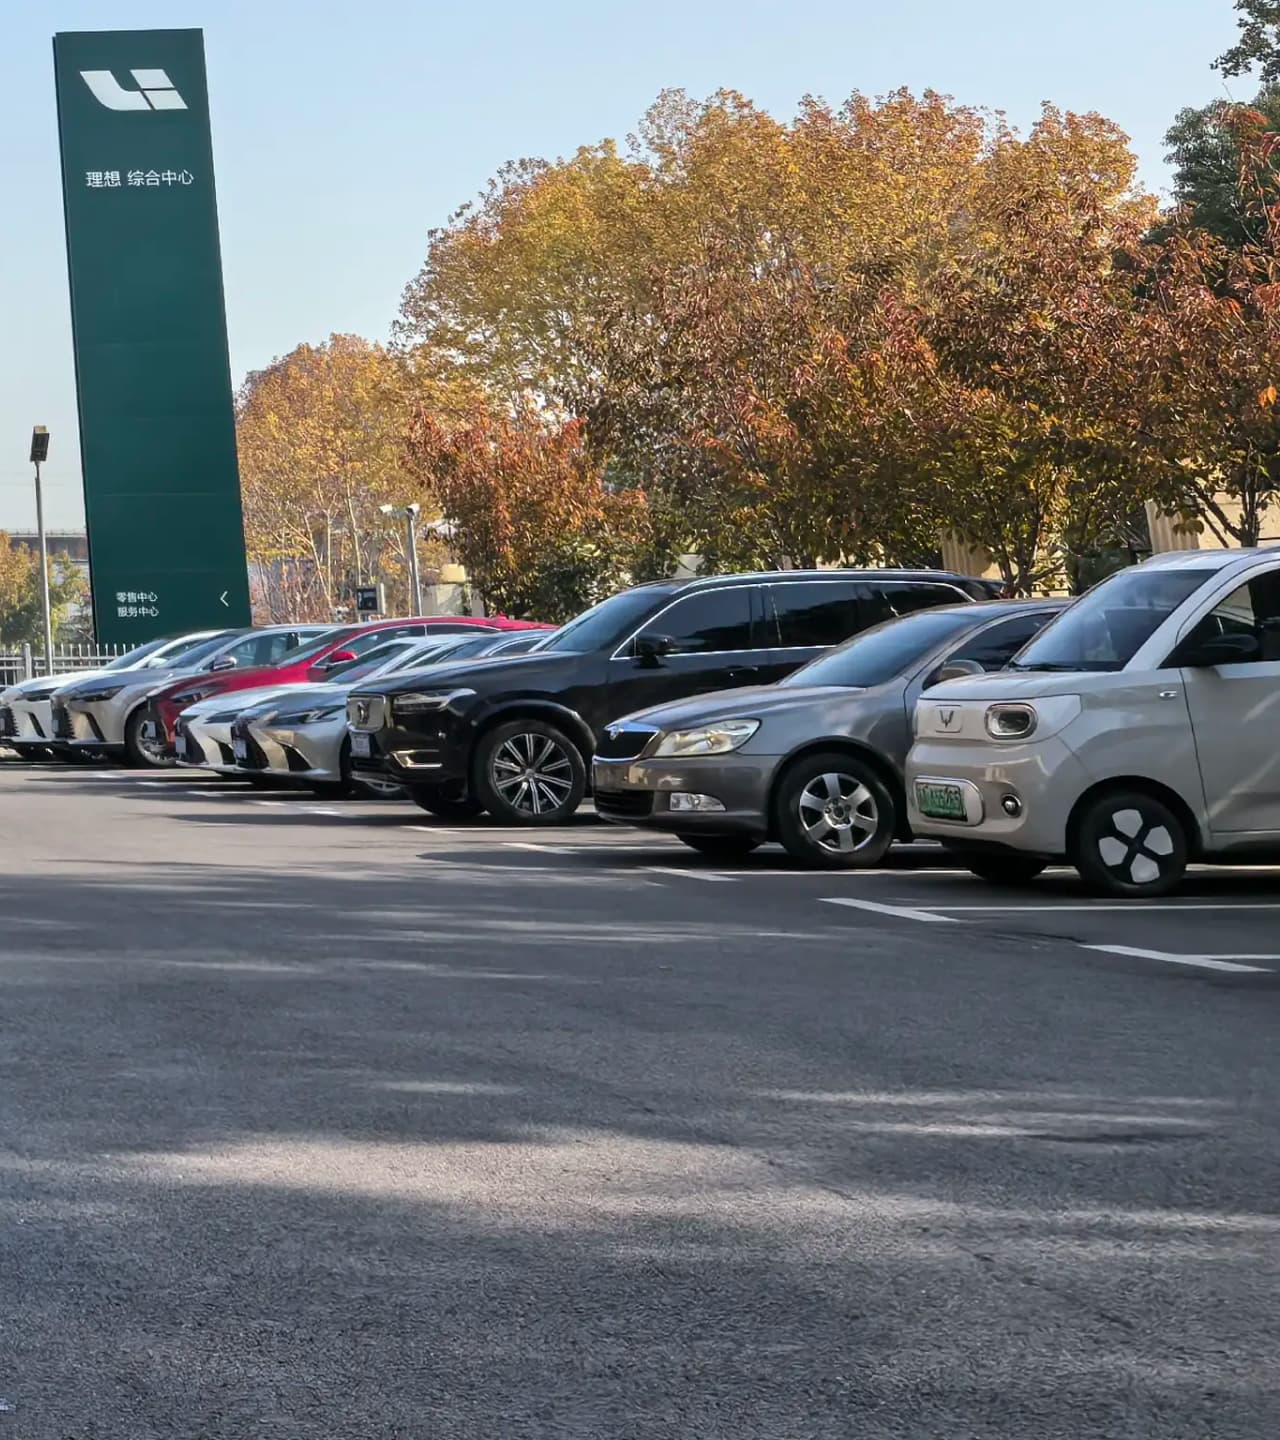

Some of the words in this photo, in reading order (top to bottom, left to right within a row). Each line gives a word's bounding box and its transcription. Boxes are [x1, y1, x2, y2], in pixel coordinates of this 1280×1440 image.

[85, 170, 122, 188] 理想
[127, 169, 195, 187] 综合中心
[116, 591, 158, 603] 零售中心
[117, 606, 160, 618] 服务中心
